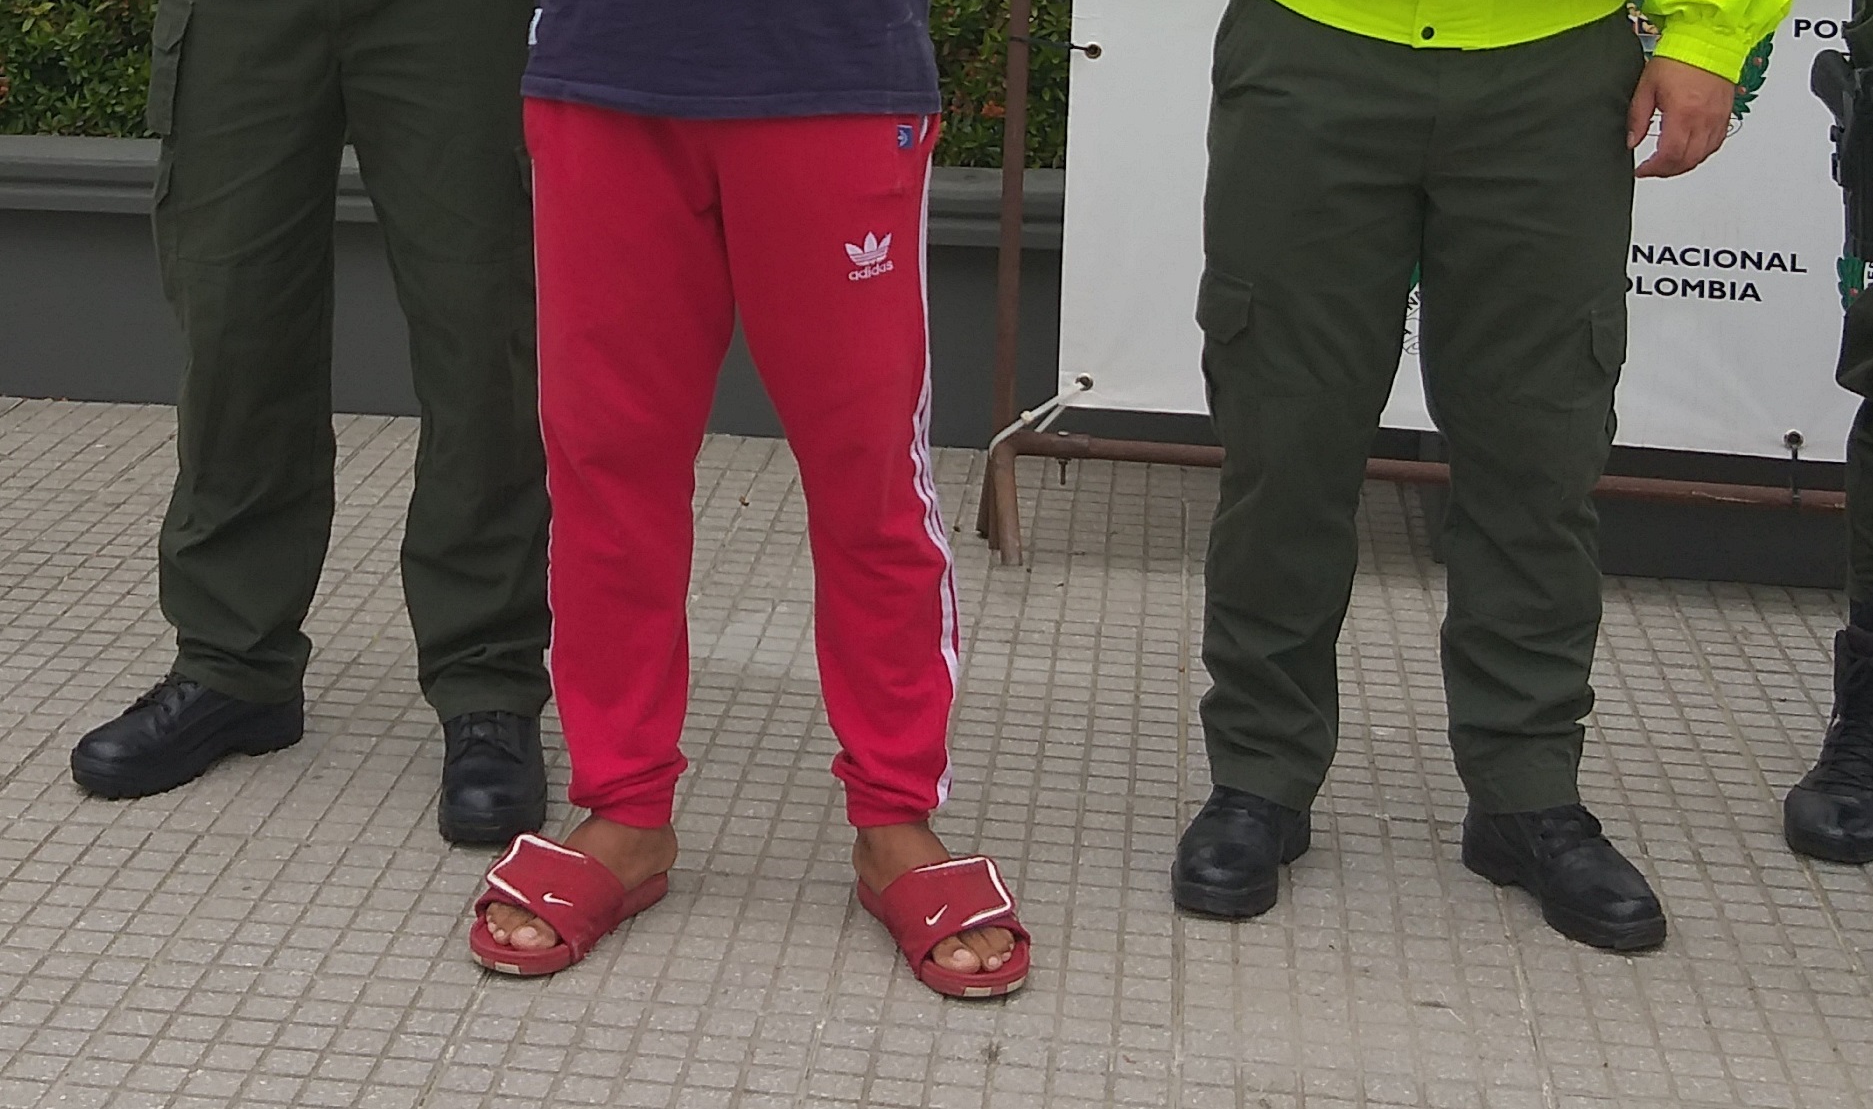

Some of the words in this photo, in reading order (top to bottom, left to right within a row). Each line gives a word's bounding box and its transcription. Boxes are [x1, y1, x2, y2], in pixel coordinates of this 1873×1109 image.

[848, 260, 894, 280] adidas
[1631, 244, 1808, 274] NACIONAL
[1627, 275, 1763, 302] LOMBIA
